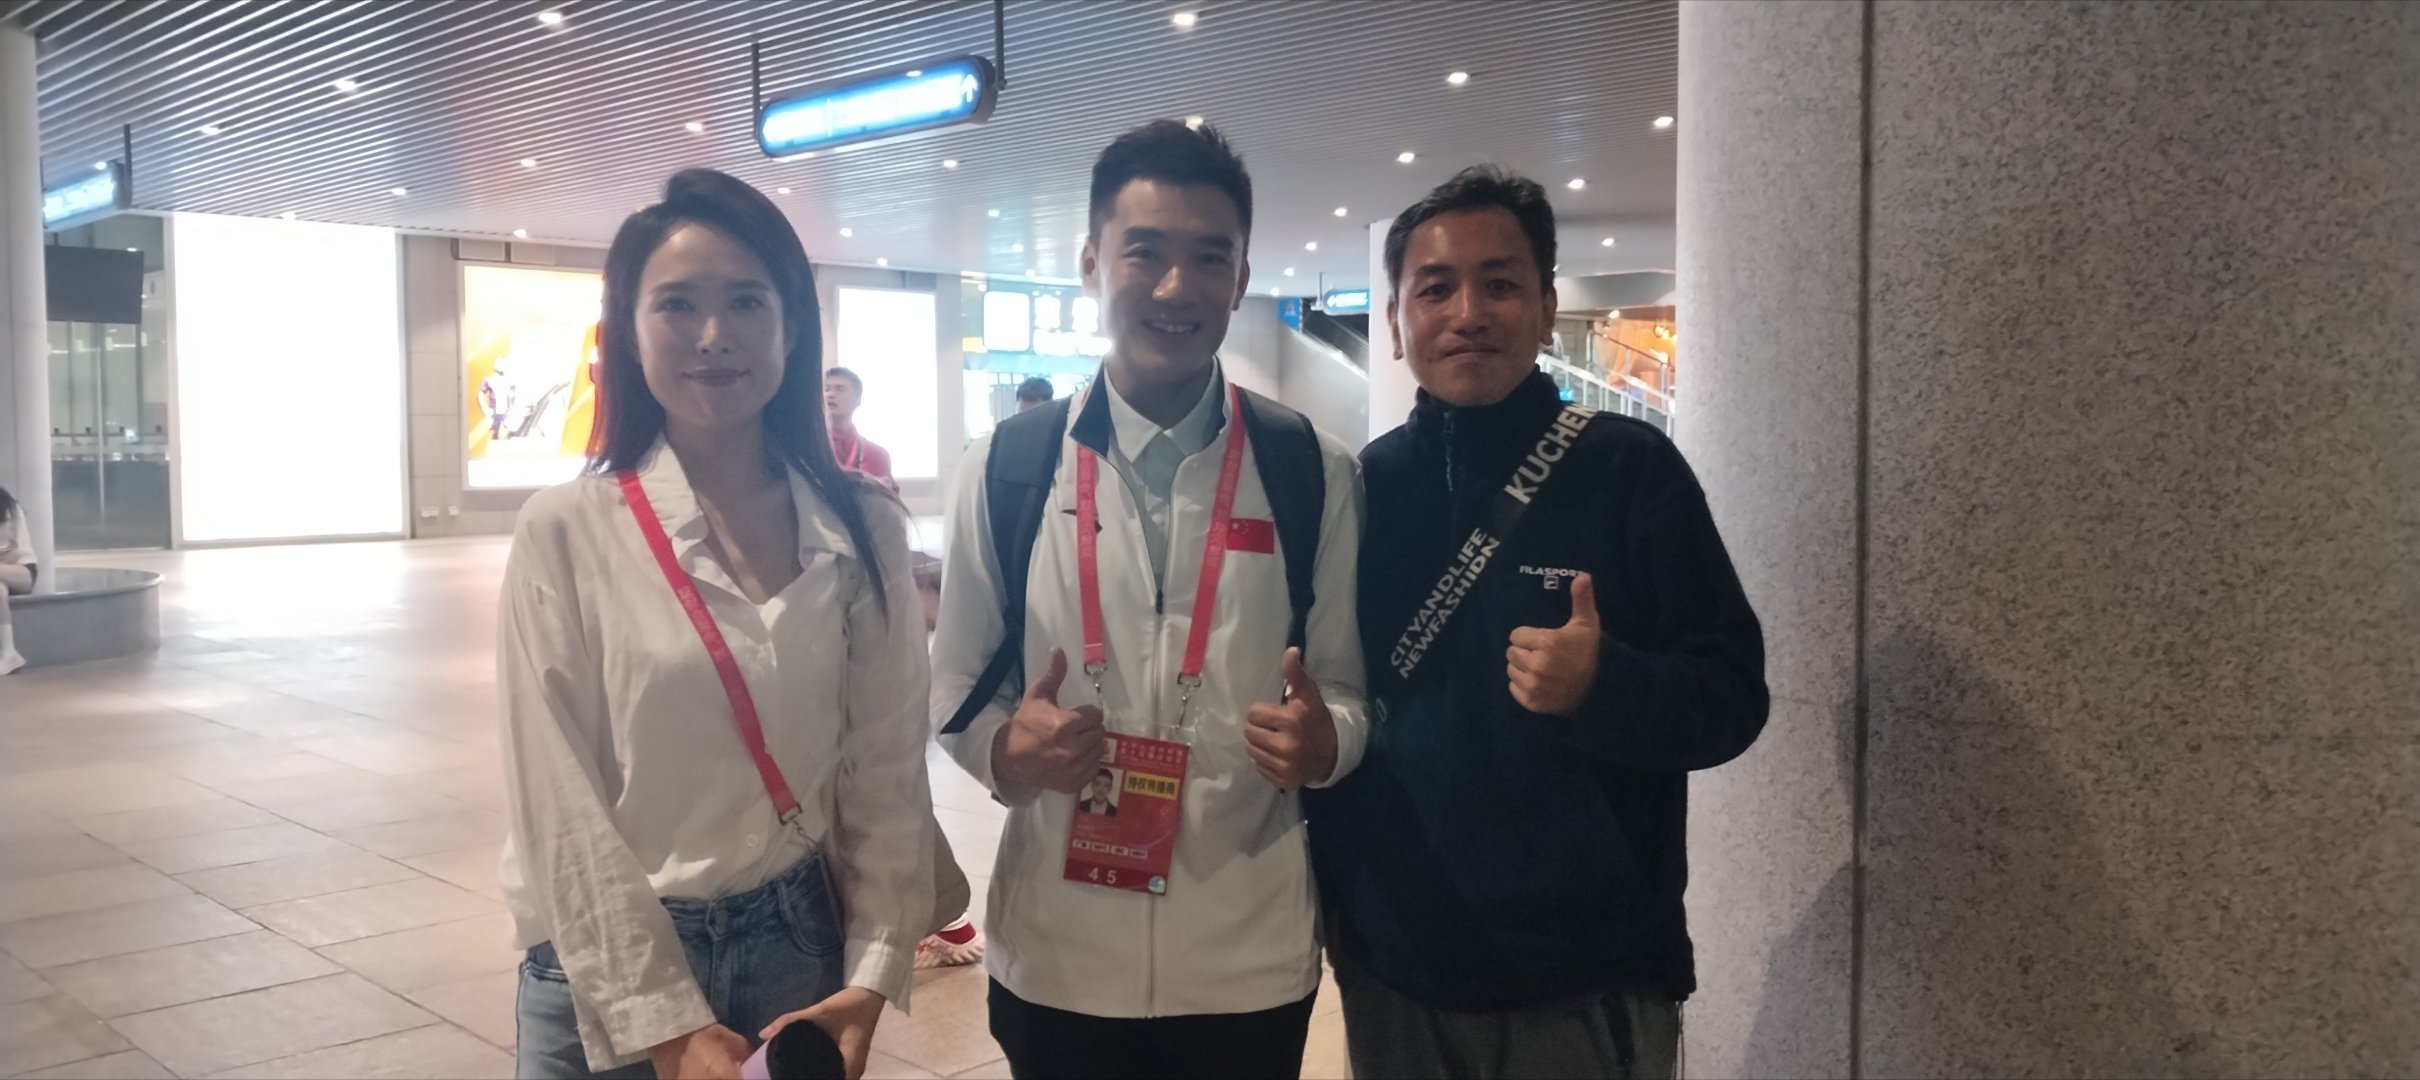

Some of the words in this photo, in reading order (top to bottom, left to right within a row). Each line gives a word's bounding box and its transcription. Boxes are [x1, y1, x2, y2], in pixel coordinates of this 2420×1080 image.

[1391, 528, 1487, 666] CITYANDLIFE
[1088, 867, 1099, 881] 4
[1107, 870, 1117, 884] 5
